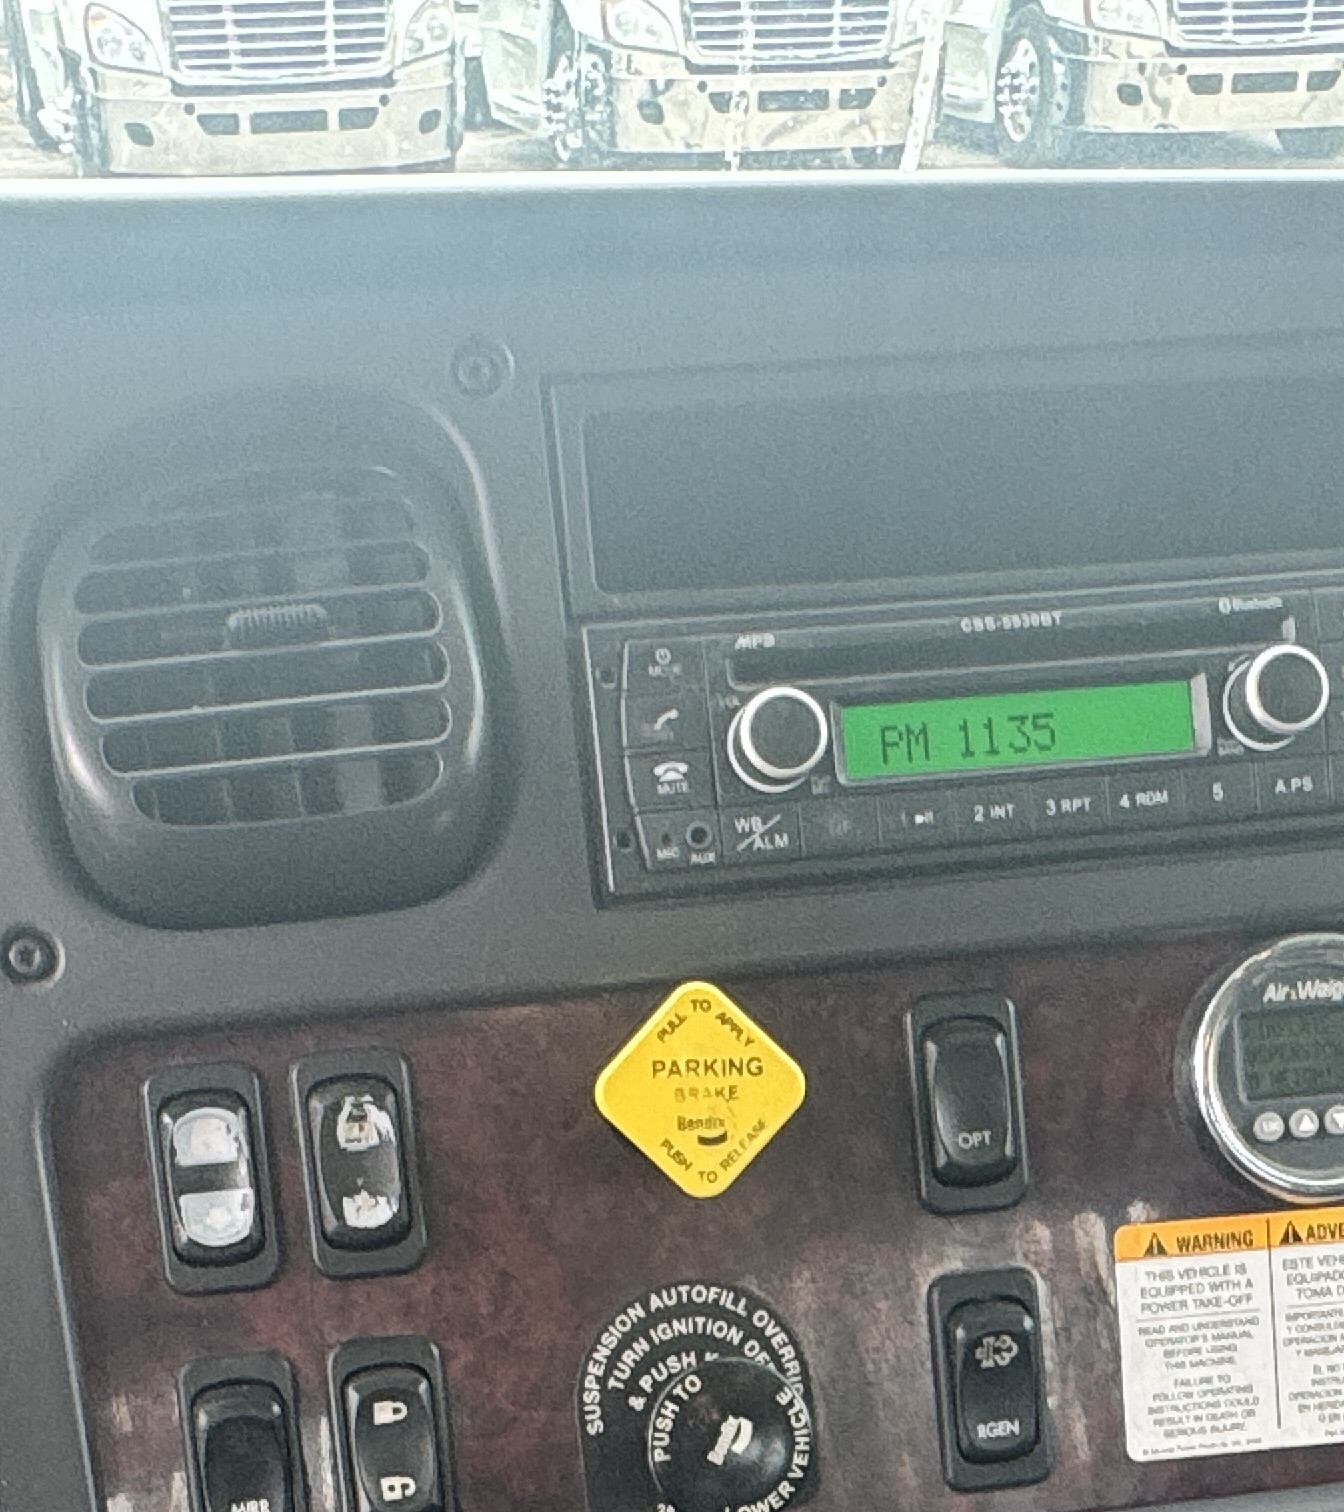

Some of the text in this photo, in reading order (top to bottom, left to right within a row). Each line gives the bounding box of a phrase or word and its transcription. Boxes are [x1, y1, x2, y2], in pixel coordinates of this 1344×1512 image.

[880, 712, 1056, 765] PM 1135
[1046, 799, 1056, 816] 3
[1120, 792, 1129, 809] 4
[974, 805, 984, 822] 2
[657, 999, 756, 1047] PULL TO APPLY
[651, 1056, 764, 1079] PARKING
[674, 1085, 740, 1103] BRAKE
[659, 1119, 767, 1184] PUSH TO RELEASE
[958, 1130, 992, 1150] OPT
[1176, 1229, 1253, 1253] WARNING
[1145, 1269, 1174, 1281] THIS
[1177, 1263, 1230, 1280] VEHICLE
[1208, 1280, 1241, 1293] WITH
[1245, 1278, 1253, 1289] A
[1141, 1299, 1188, 1314] POWER
[582, 1284, 804, 1436] SUSPENSION AUTOFILL OVERRID
[606, 1337, 651, 1391] TURN
[649, 1316, 744, 1347] IGNITION
[638, 1350, 698, 1395] PUSH
[653, 1374, 703, 1462] PUSH TO
[775, 1387, 811, 1480] VEHICLE
